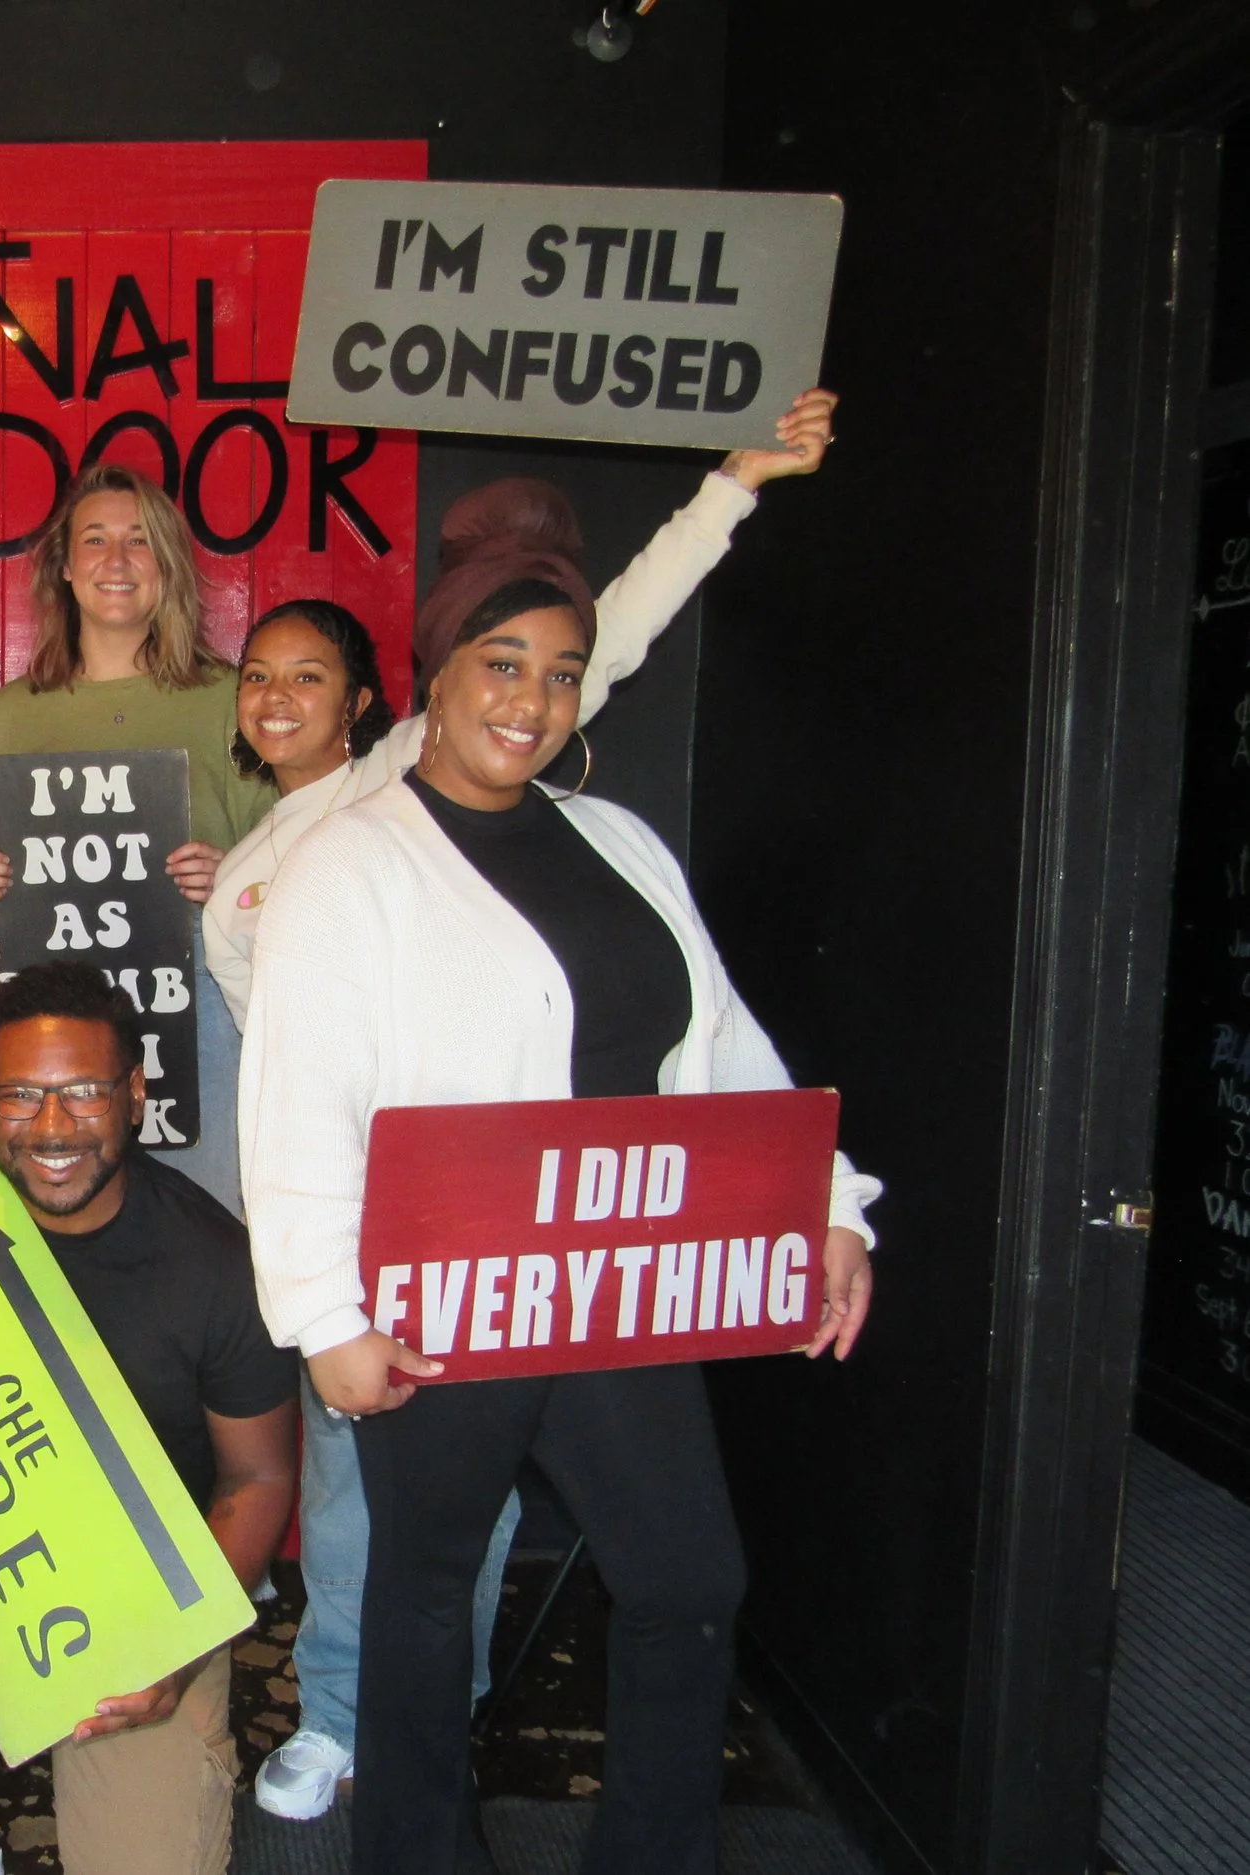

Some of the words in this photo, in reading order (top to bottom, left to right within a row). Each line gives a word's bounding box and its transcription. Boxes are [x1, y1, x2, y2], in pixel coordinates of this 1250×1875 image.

[374, 218, 485, 294] I'M
[521, 224, 739, 306] STILL
[331, 321, 763, 414] CONFUSED
[30, 764, 136, 817] I'M
[21, 832, 150, 885] NOT
[46, 901, 131, 951] AS
[535, 1148, 562, 1224] I
[574, 1143, 688, 1222] DID
[373, 1232, 810, 1356] EVERYTHING
